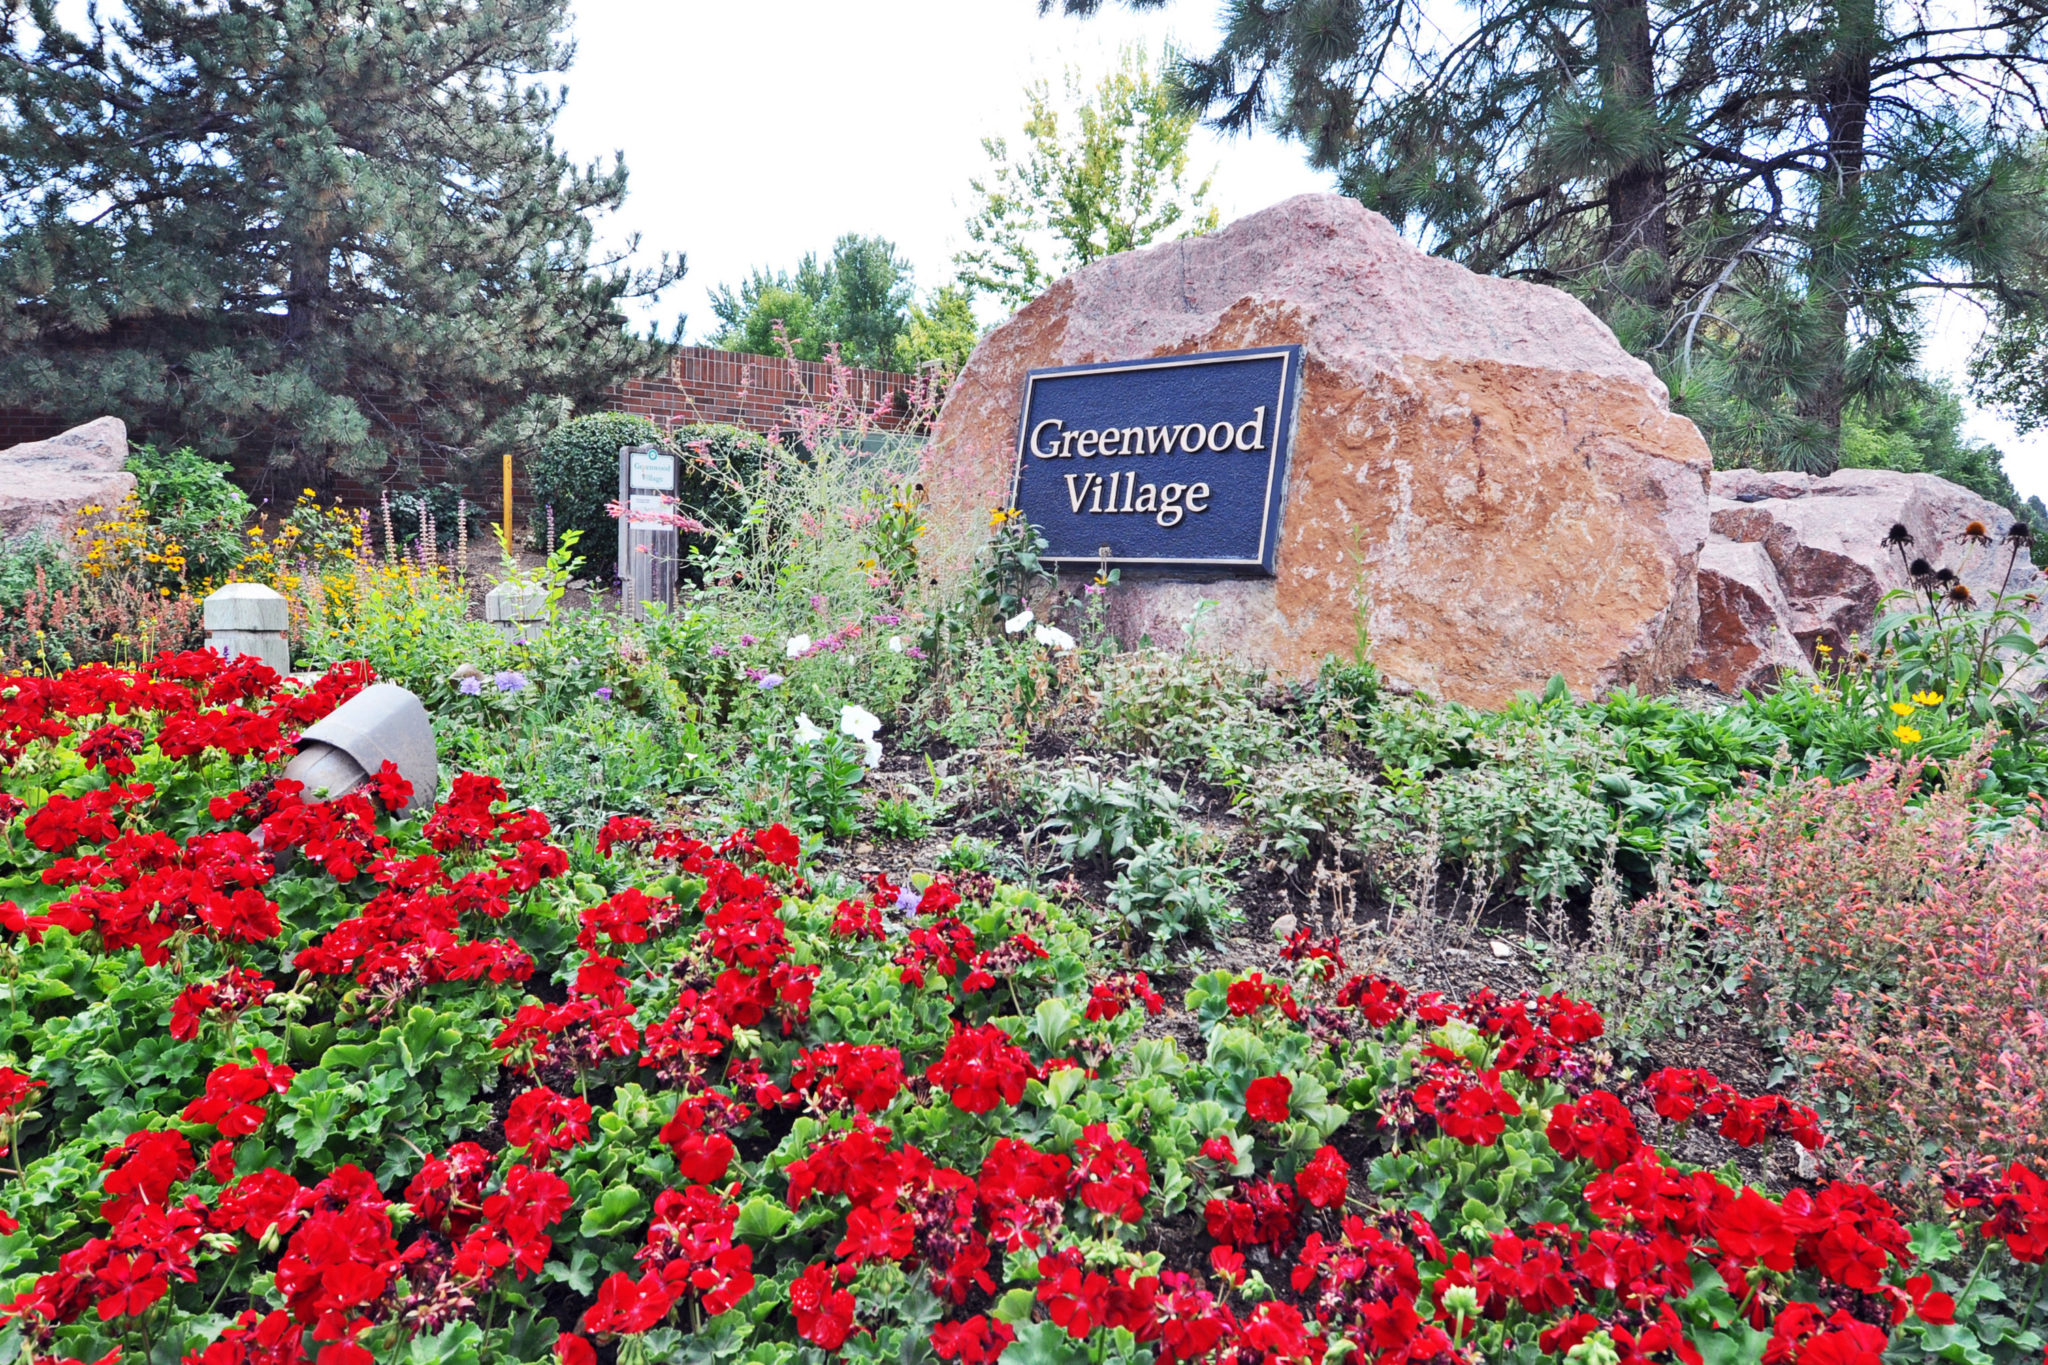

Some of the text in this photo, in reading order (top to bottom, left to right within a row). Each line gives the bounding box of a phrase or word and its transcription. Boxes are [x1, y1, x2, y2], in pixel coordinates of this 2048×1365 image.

[1030, 405, 1266, 459] Greenwood
[634, 463, 671, 472] Grenwood
[1064, 471, 1210, 527] Village
